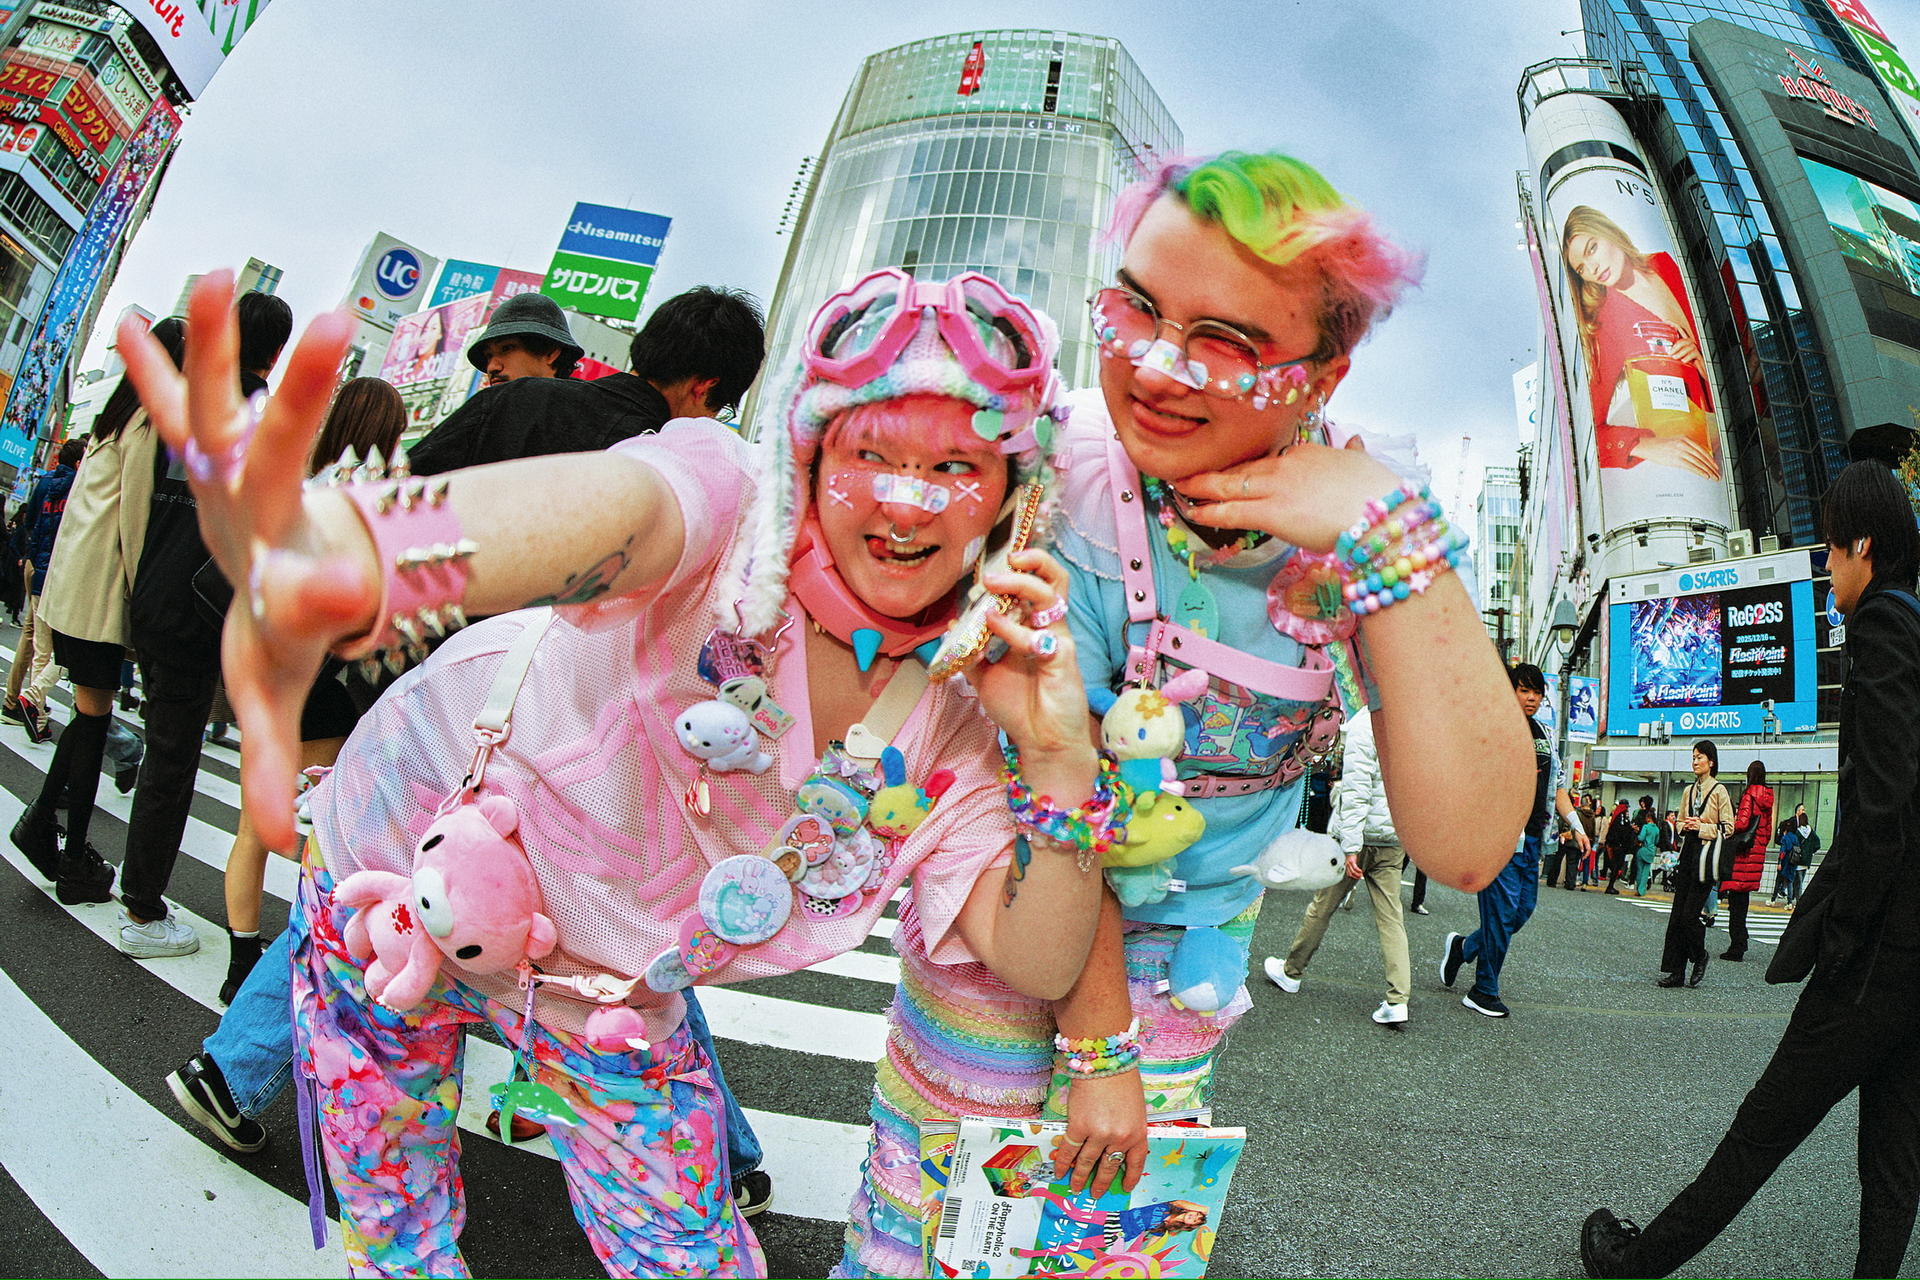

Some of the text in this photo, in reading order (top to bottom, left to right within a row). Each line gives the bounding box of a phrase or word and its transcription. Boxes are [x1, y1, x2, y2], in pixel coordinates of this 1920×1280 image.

[65, 84, 110, 143] コンタクト
[1777, 74, 1878, 131] MAGNET
[568, 221, 662, 247] Hisamitsu
[551, 267, 640, 302] サロンパス
[1652, 386, 1684, 395] CHANEL
[1695, 569, 1738, 588] STARTS
[1696, 712, 1741, 729] STARTS
[982, 1203, 1000, 1255] ON THE EARTH
